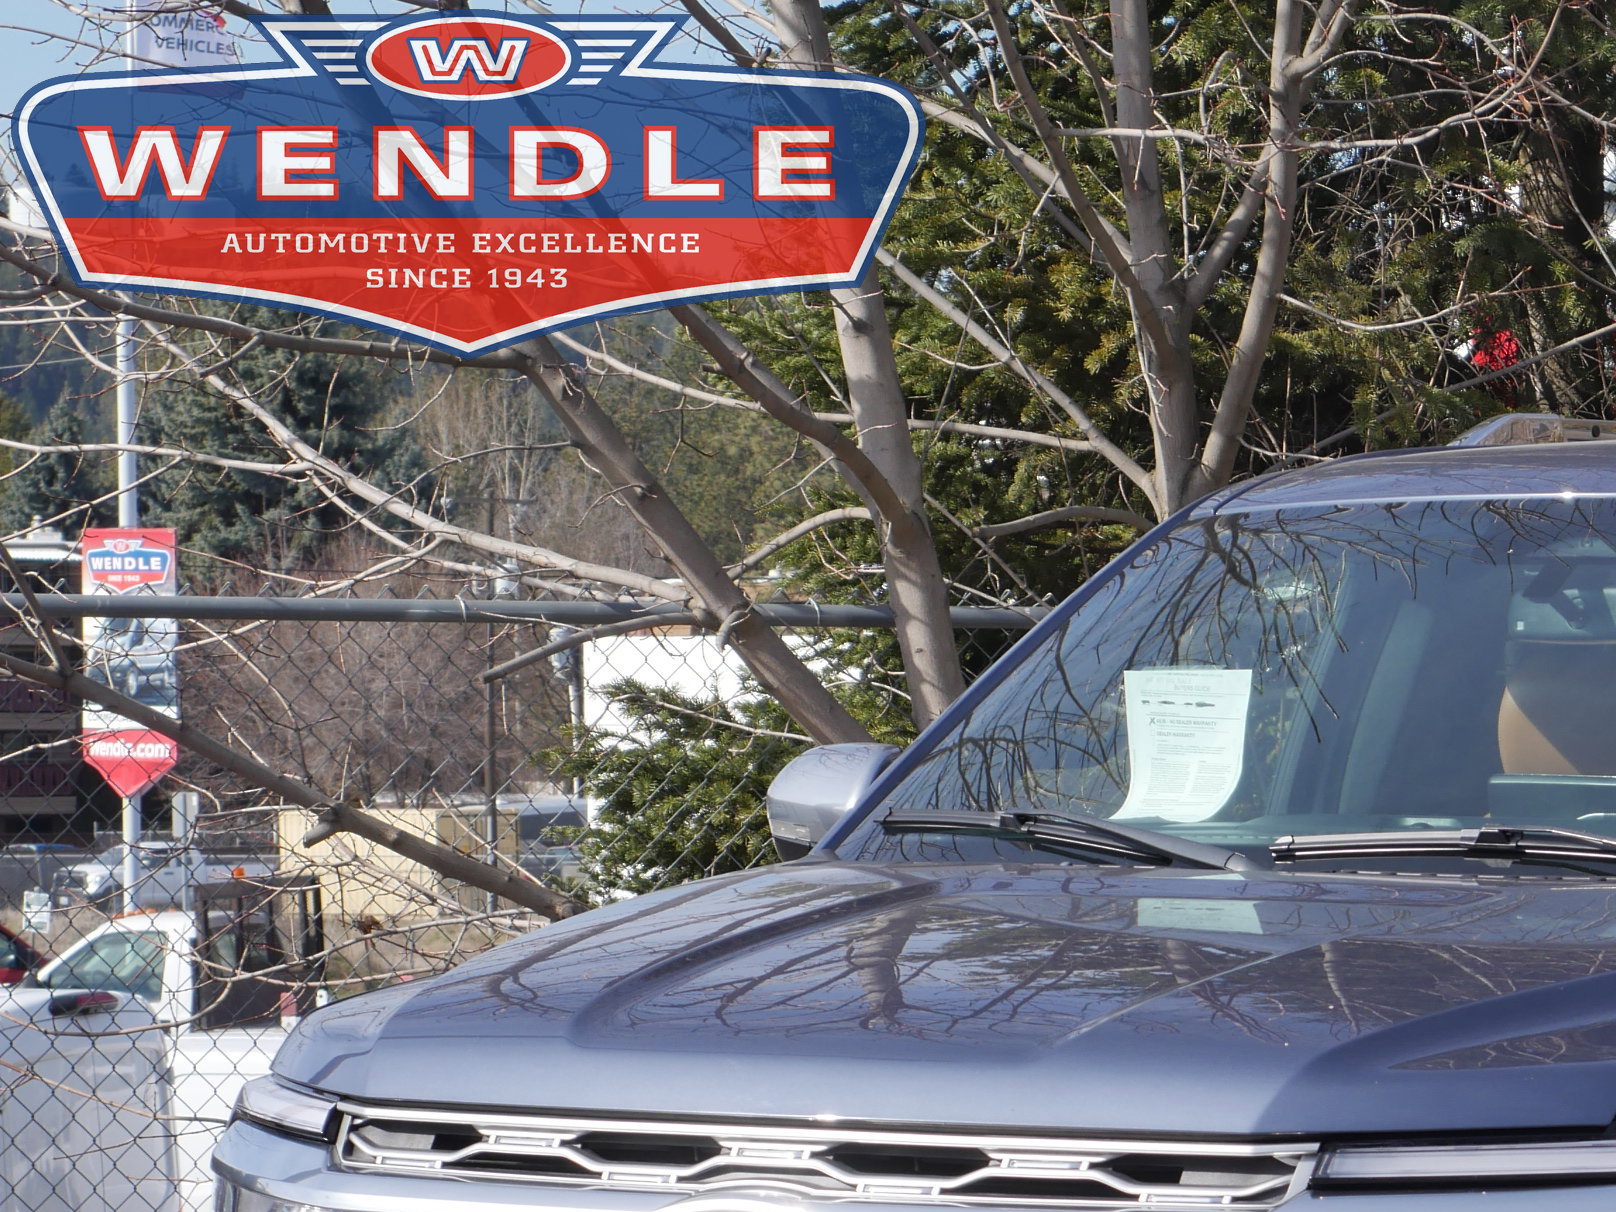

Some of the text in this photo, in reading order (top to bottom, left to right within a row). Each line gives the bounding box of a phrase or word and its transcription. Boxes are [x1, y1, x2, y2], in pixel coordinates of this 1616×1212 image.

[148, 14, 227, 36] OMMERC
[155, 36, 236, 57] VEHICLES
[90, 556, 162, 570] WENDLE
